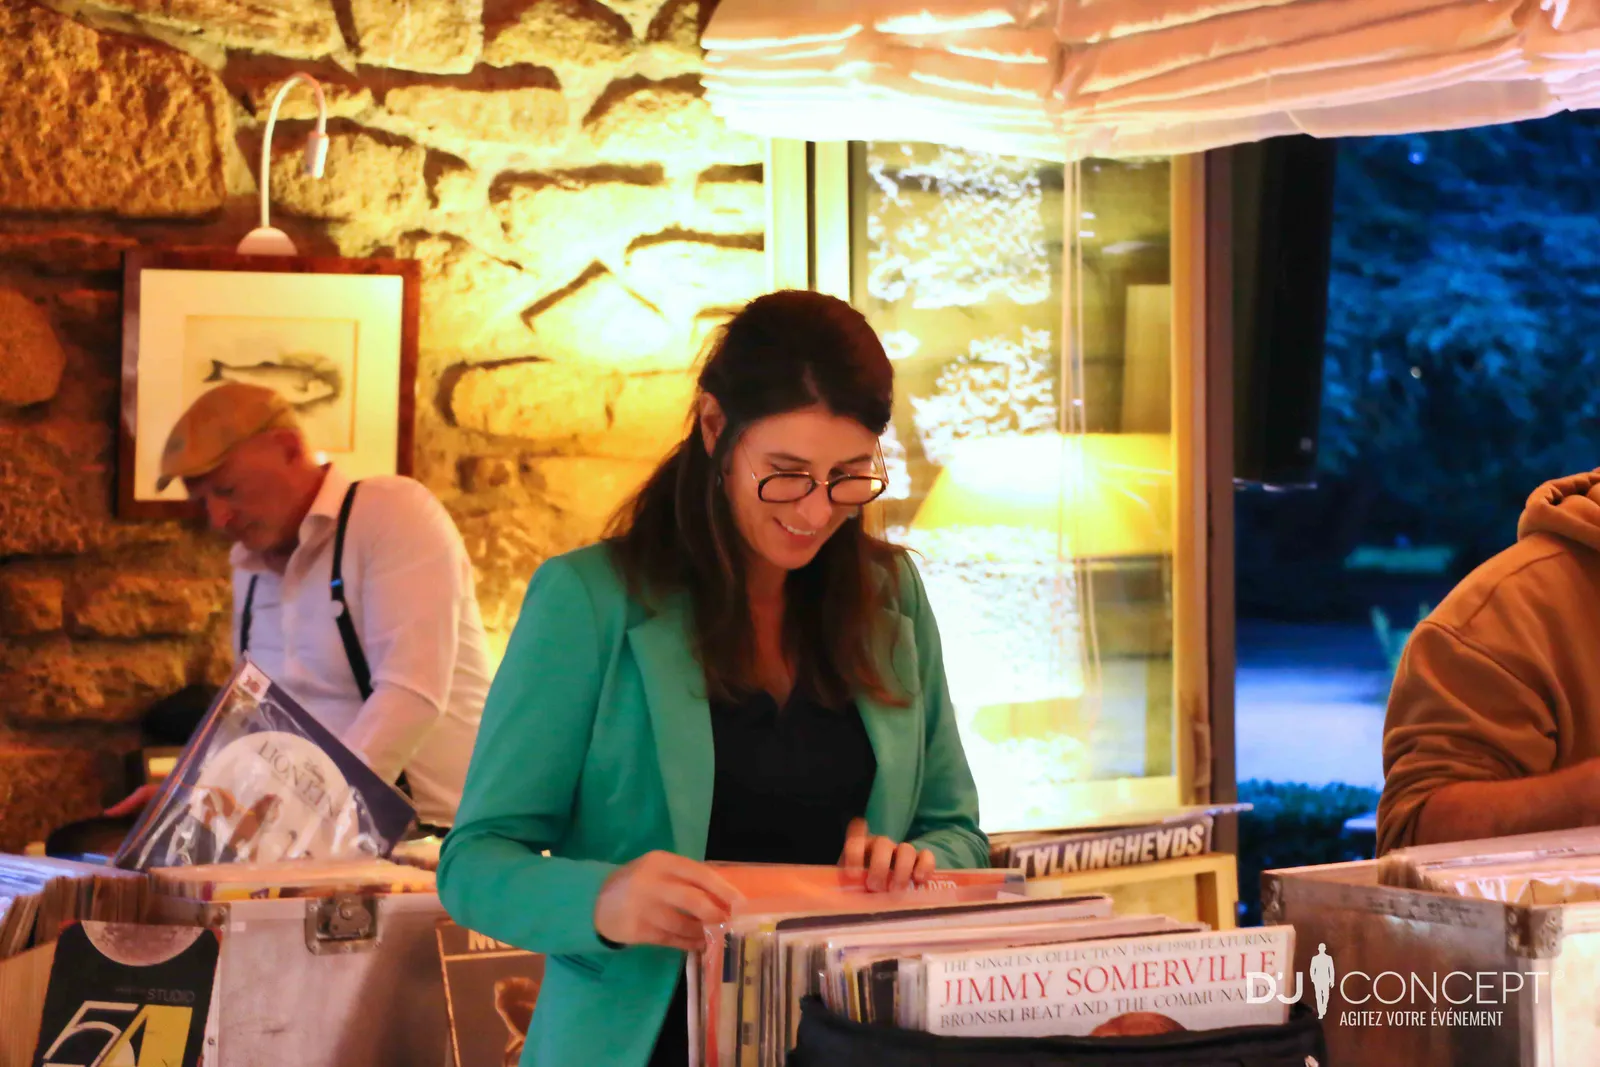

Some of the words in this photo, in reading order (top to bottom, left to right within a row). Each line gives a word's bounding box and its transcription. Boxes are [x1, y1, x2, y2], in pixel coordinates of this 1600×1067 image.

[259, 740, 299, 787] LION
[943, 960, 968, 974] THE
[975, 953, 1034, 970] SINGLES
[1036, 943, 1127, 964] COLLECTION
[1200, 931, 1279, 950] FEATURING
[147, 988, 195, 1003] STUDIO
[940, 971, 1053, 1008] JIMMY
[1066, 950, 1277, 996] SOMERVILLE
[940, 1009, 1015, 1028] BRONSKI
[1021, 1004, 1066, 1021] BEAT
[1070, 1001, 1109, 1016] AND
[1117, 995, 1147, 1012] THE
